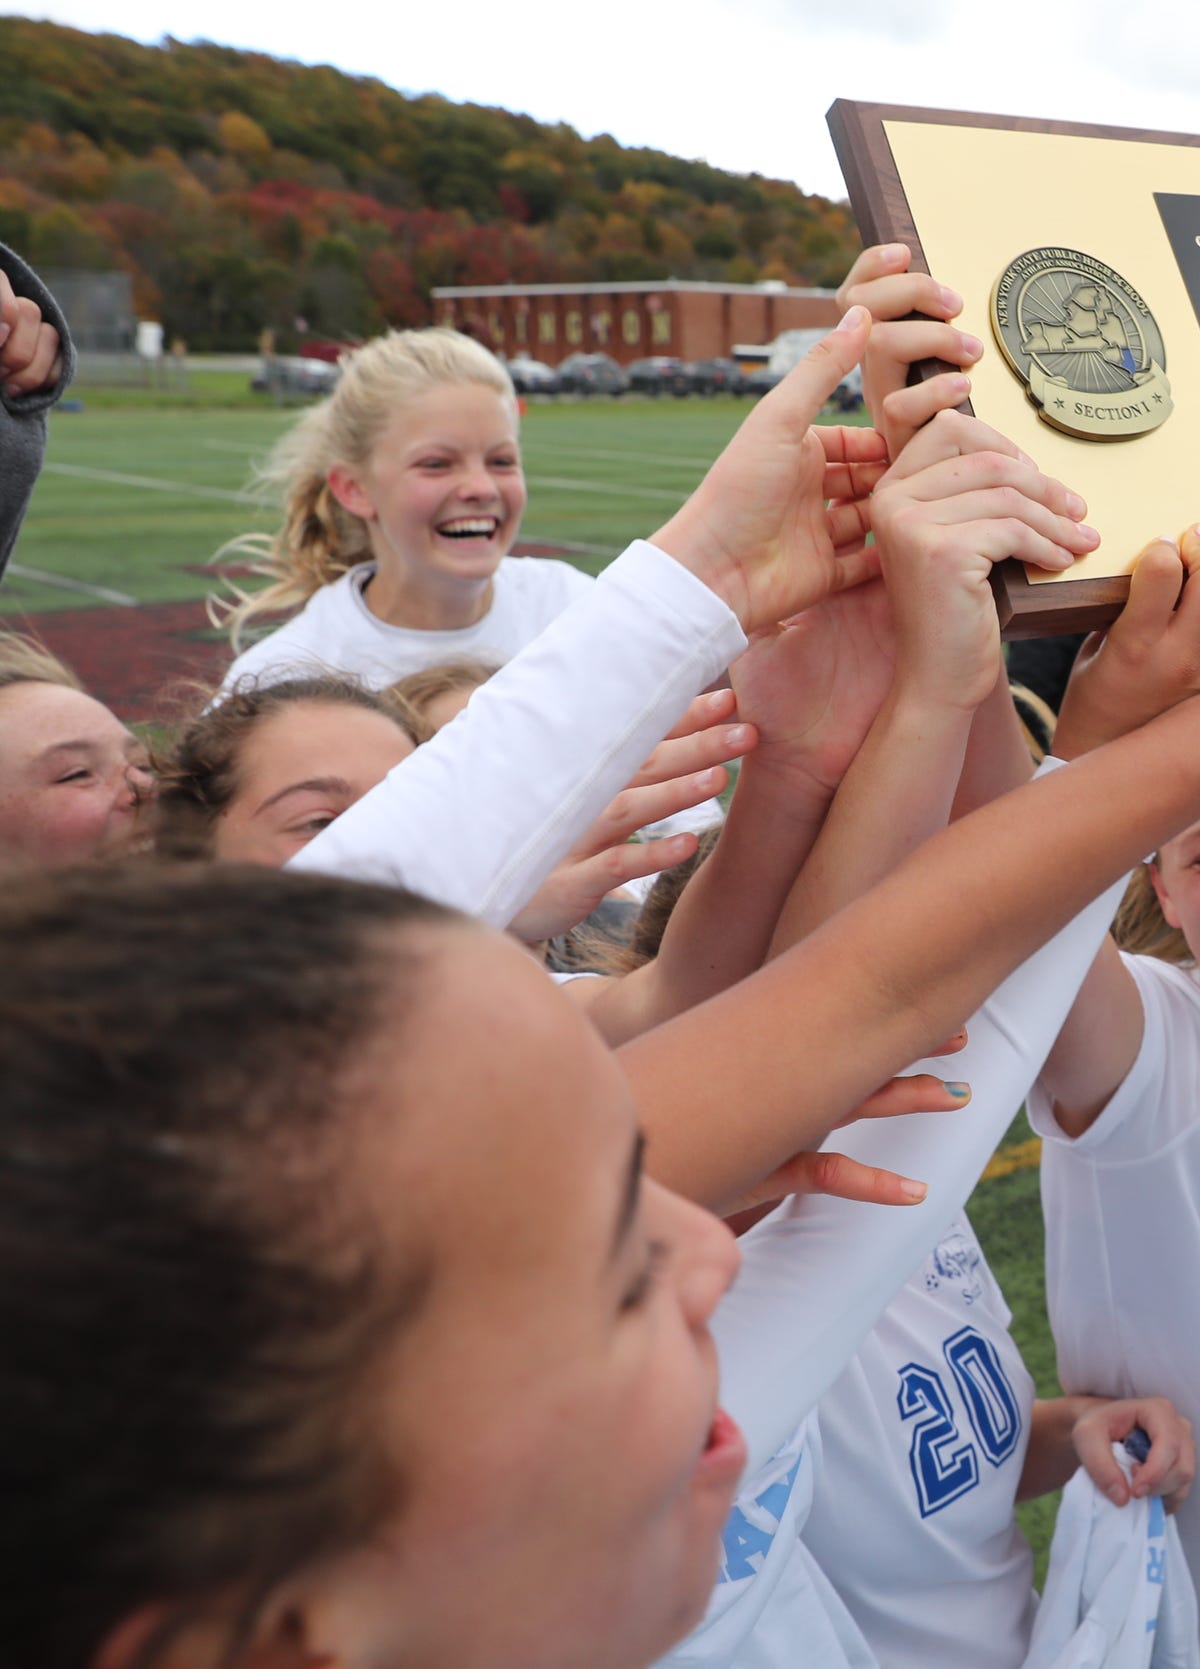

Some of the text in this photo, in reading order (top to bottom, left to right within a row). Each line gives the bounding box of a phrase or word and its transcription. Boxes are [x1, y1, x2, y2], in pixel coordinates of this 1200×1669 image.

[998, 249, 1150, 328] NEW YORK STATE PUBLIC HIGH SCHOOL
[1021, 259, 1108, 283] ATHLETIC ASSOCIATION
[441, 311, 671, 346] LINGTON
[1074, 402, 1138, 420] SECTION
[896, 1325, 1021, 1519] 20
